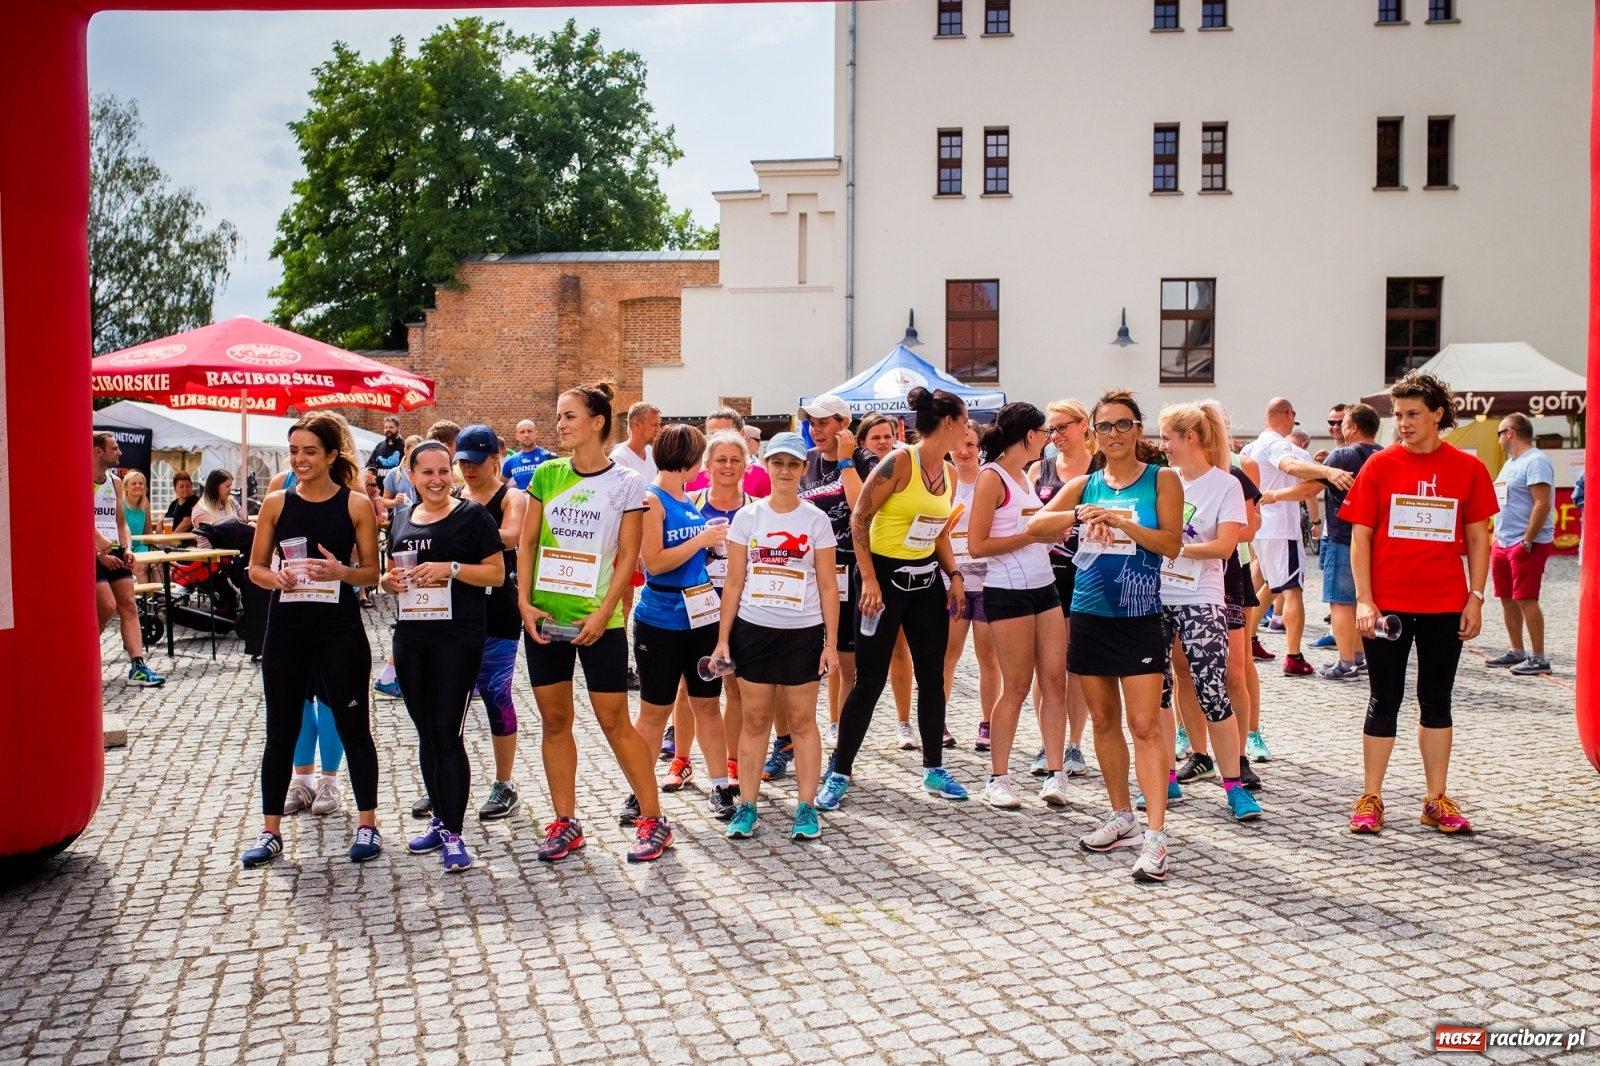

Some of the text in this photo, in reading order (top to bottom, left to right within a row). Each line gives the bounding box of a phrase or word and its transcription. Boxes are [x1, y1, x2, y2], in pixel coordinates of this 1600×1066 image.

[205, 371, 335, 387] RACIBORSKIE
[1529, 391, 1587, 415] gofry
[551, 506, 601, 521] AKTYWNI
[1416, 512, 1432, 524] 53
[551, 527, 595, 540] GEOFART
[927, 527, 939, 537] 15
[407, 538, 432, 551] STAY
[558, 564, 574, 577] 30
[769, 580, 785, 592] 37
[416, 593, 429, 605] 29
[704, 595, 715, 607] 40
